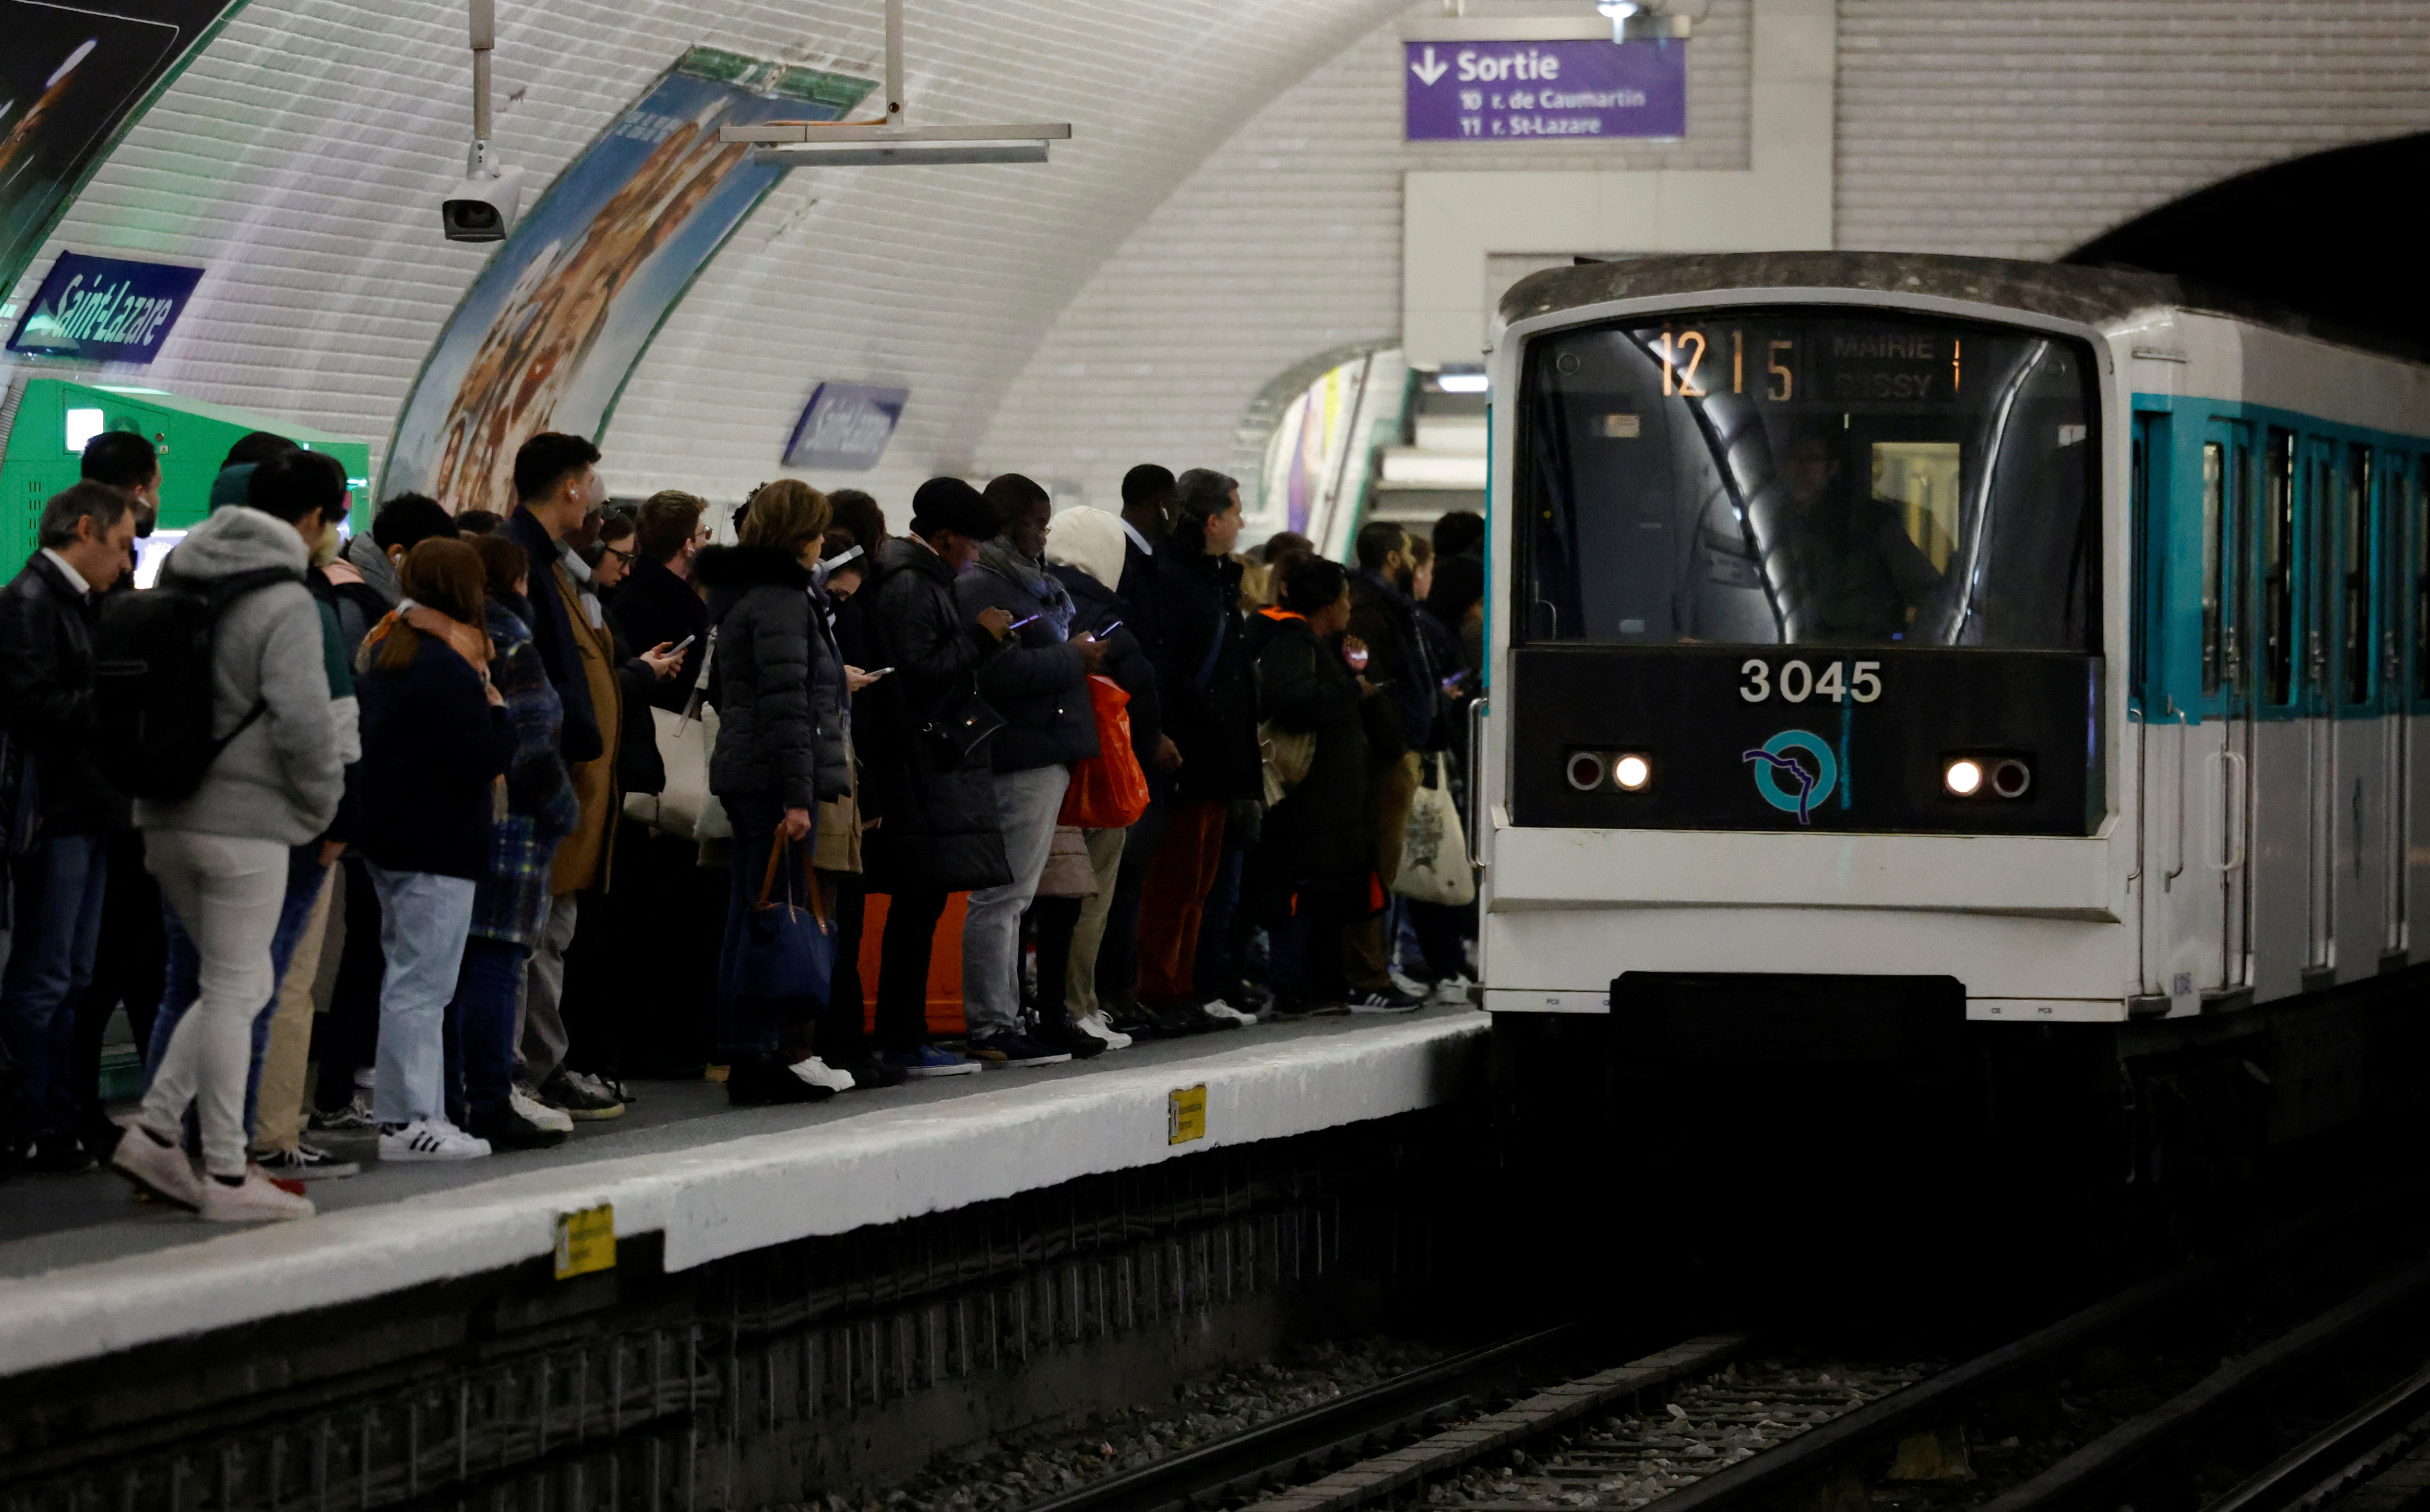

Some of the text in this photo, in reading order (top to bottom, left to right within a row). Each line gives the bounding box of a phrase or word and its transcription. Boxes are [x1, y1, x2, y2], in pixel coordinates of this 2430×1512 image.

[1457, 50, 1559, 81] Sortie
[1461, 91, 1646, 110] 10 r. de Caumartin
[1462, 118, 1481, 136] 11
[1510, 116, 1602, 135] St-Lazare
[41, 274, 173, 346] Saint-Lazare
[1833, 335, 1934, 359] MAIRIE
[1660, 330, 1706, 397] 12
[1740, 659, 1881, 703] 3045
